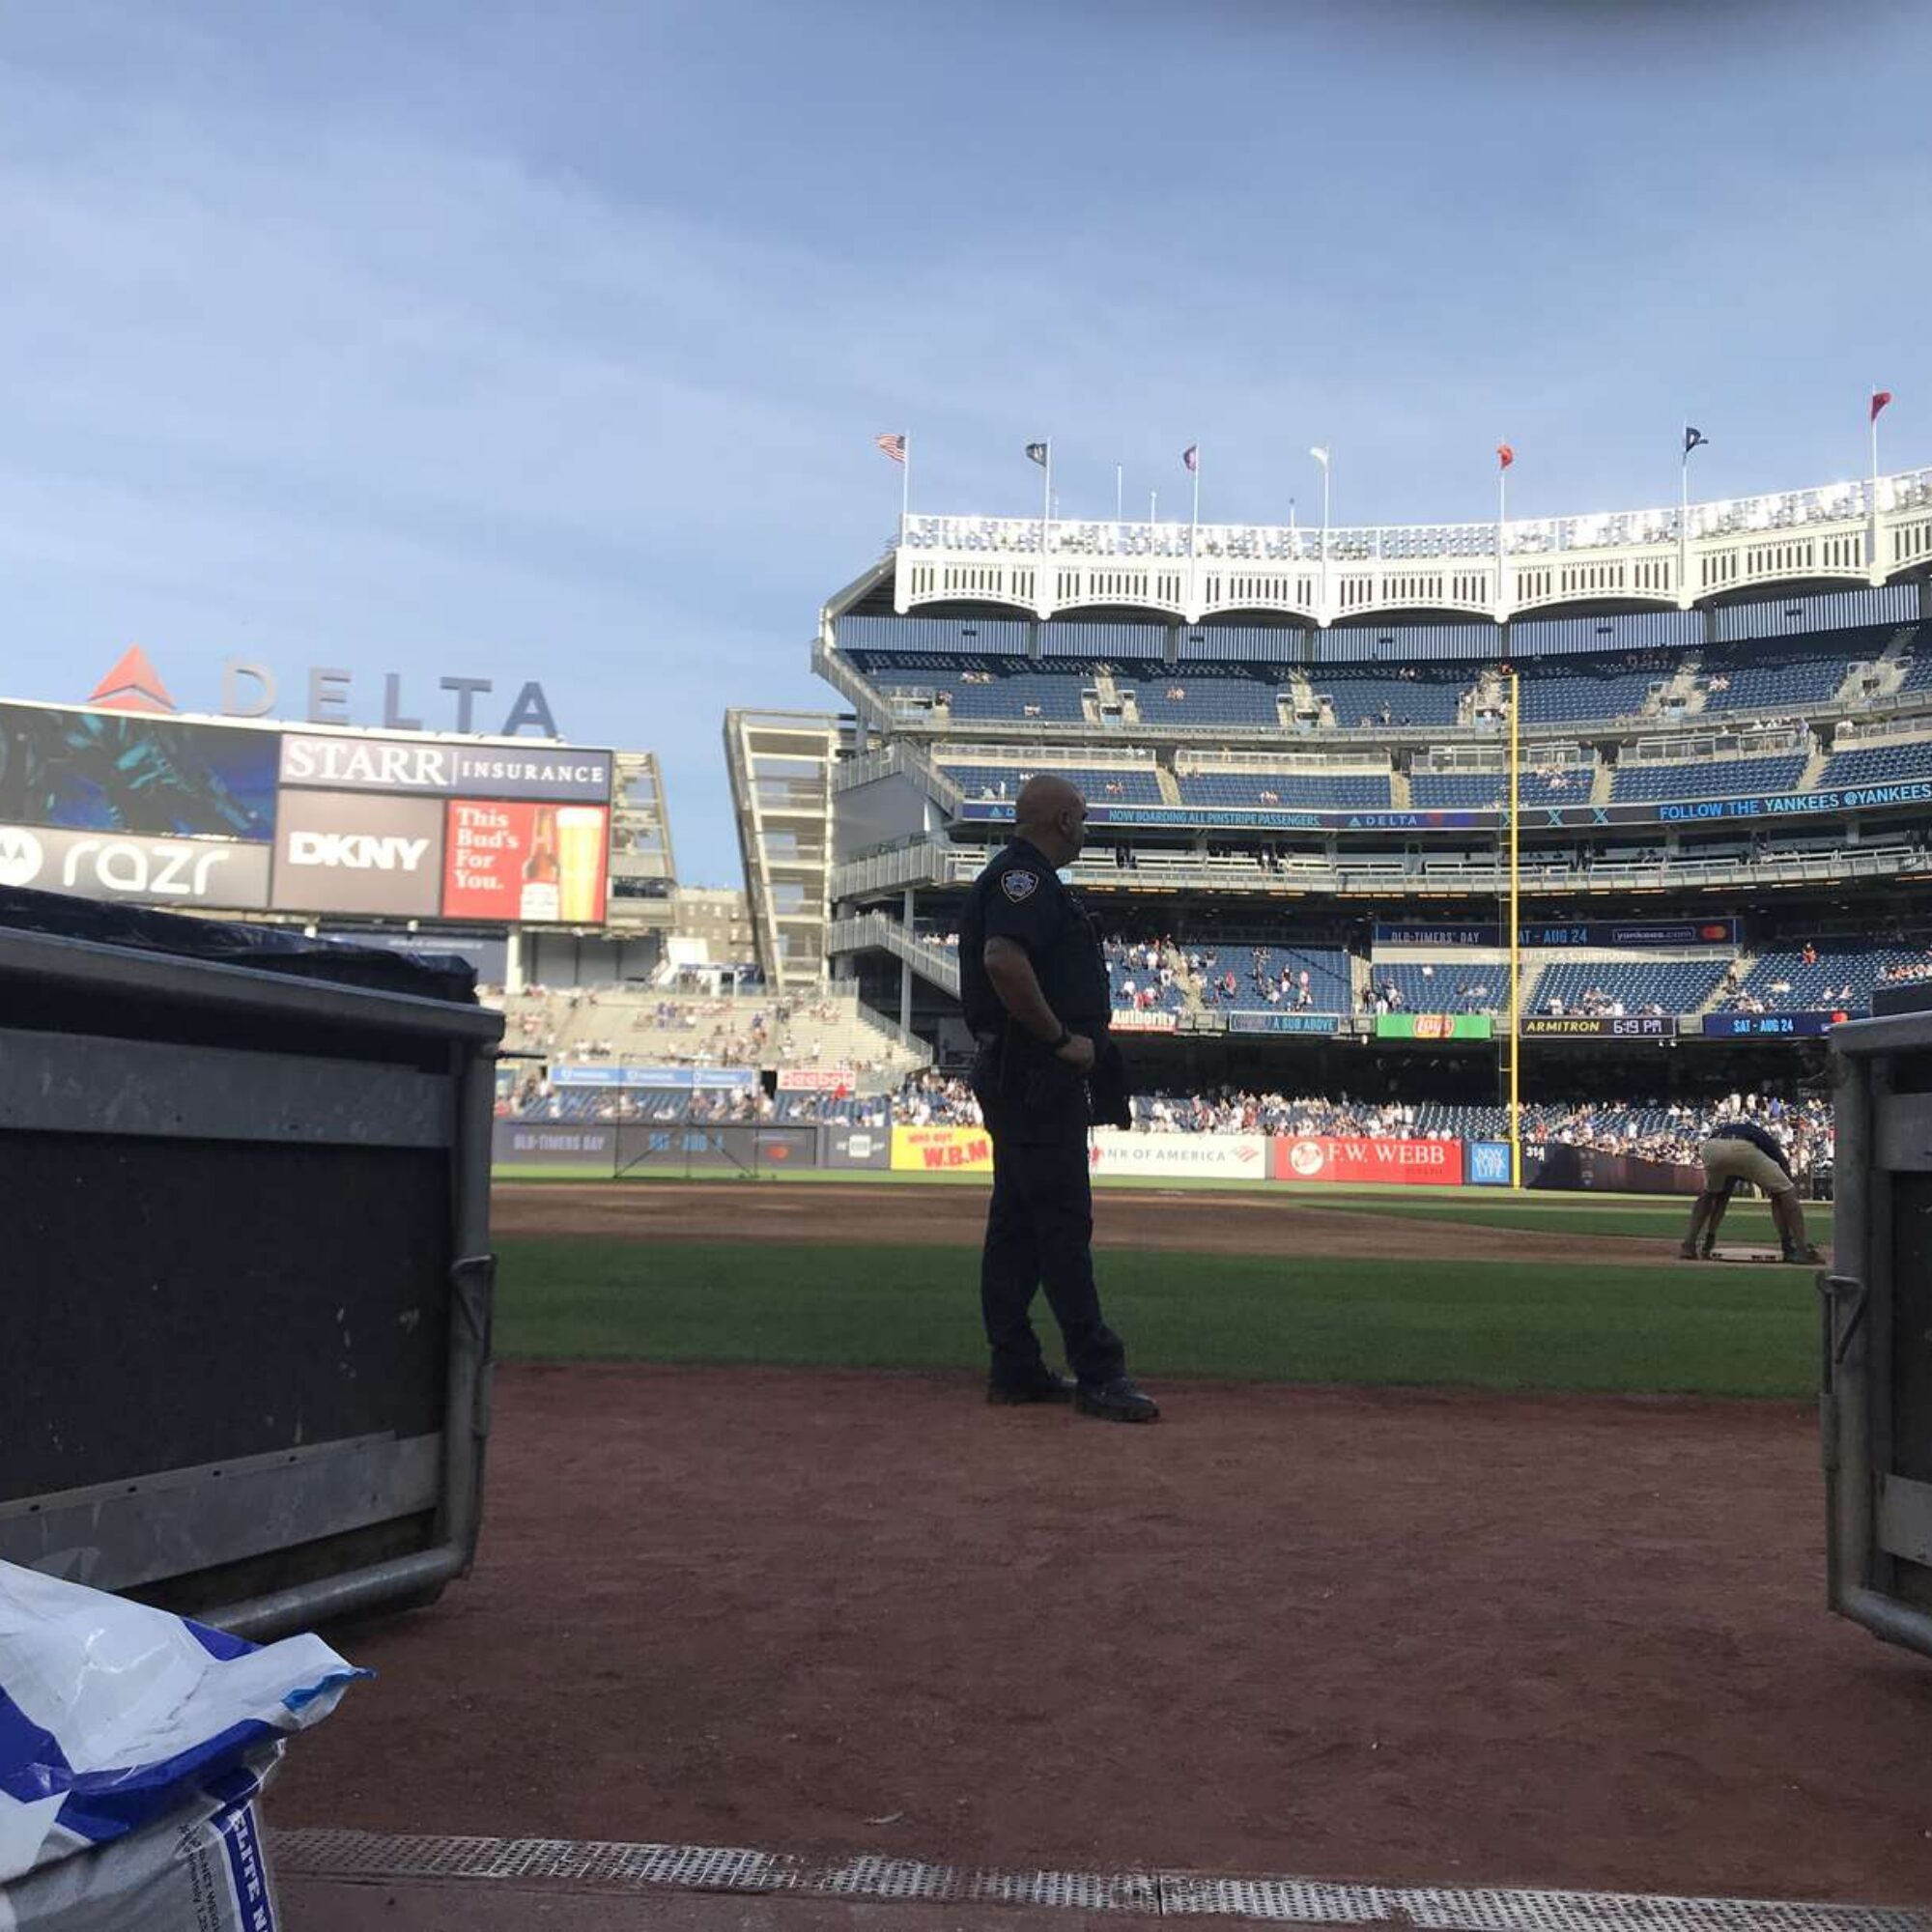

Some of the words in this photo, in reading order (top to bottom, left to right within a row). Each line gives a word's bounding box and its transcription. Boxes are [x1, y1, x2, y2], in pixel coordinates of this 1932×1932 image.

[220, 656, 560, 738] DELTA
[287, 740, 448, 786] STARR
[463, 760, 605, 782] INSURANCE
[1660, 803, 1723, 820] FOLLOW
[1727, 800, 1759, 815] THE
[1764, 794, 1839, 812] YANKEES
[1844, 783, 1931, 806] @YANKEES
[457, 807, 509, 827] This
[1109, 810, 1134, 821] NOW
[1136, 810, 1187, 822] BOARDING
[1188, 811, 1205, 823] ALL
[1208, 811, 1257, 824] PINSTRIPE
[457, 828, 519, 849] Bud's
[288, 831, 430, 869] DKNY
[455, 849, 494, 867] For
[63, 840, 231, 895] razr
[454, 869, 503, 890] You.
[1461, 932, 1480, 943] DAY
[1544, 930, 1567, 944] AUG
[1572, 929, 1587, 943] 24
[1526, 1021, 1599, 1033] ARMITRON
[1613, 1020, 1638, 1034] 6:19
[1644, 1020, 1662, 1033] PM
[1733, 1020, 1750, 1033] SAT
[1781, 1019, 1794, 1032] 24
[923, 1139, 989, 1167] W.B.M
[1133, 1149, 1151, 1159] OF
[1156, 1149, 1226, 1162] AMERICA
[1327, 1143, 1368, 1163] F.W.
[1374, 1144, 1445, 1164] WEBB
[1525, 1146, 1545, 1162] 314
[227, 1808, 260, 1903] ELITE
